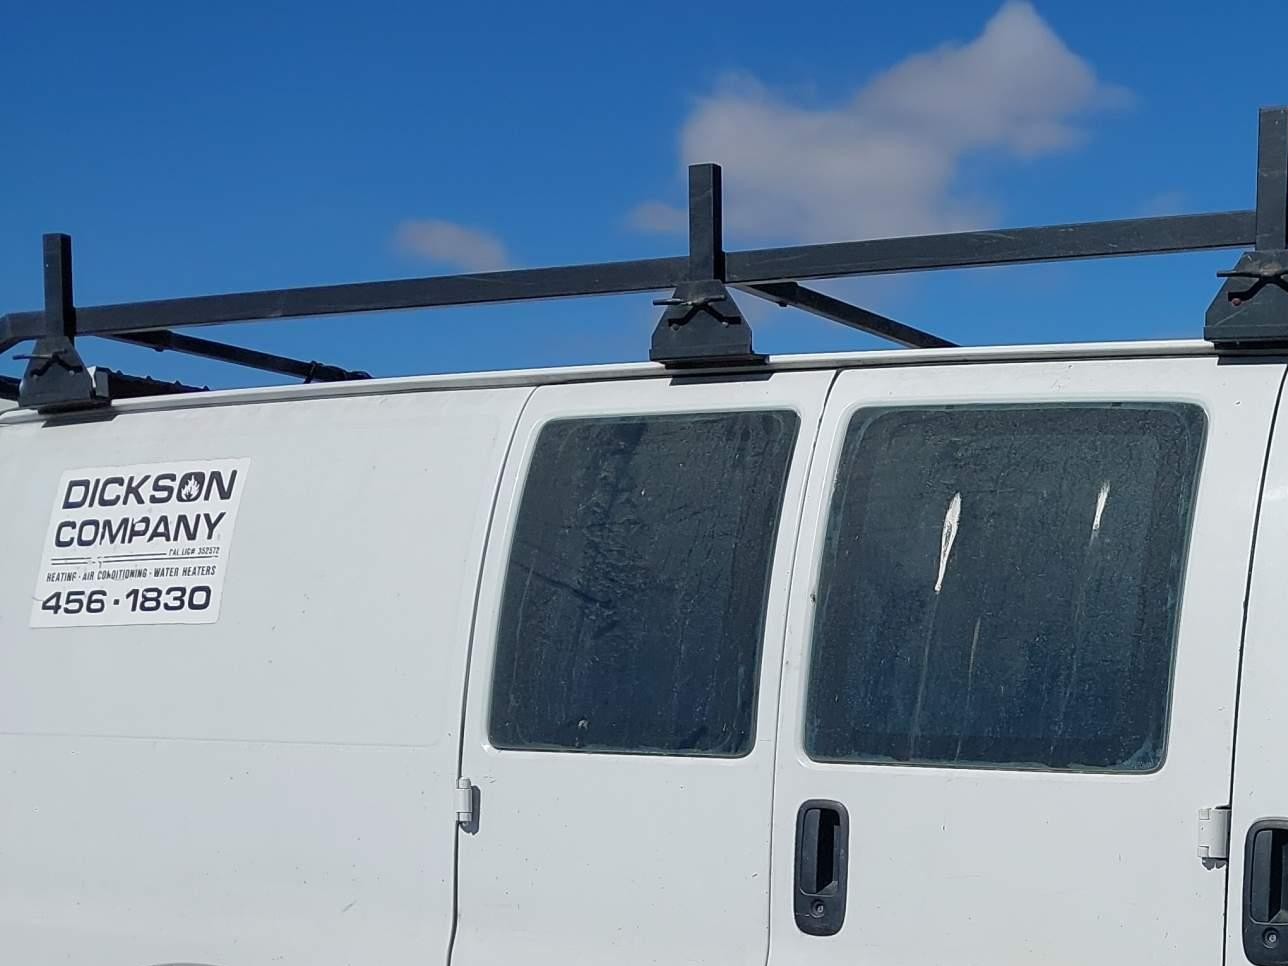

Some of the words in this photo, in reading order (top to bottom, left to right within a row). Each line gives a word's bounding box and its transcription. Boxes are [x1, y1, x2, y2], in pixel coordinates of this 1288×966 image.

[62, 469, 238, 510] DICKSON
[55, 512, 226, 548] COMPANY
[82, 570, 95, 581] AIR
[97, 568, 148, 581] CONDITIONING
[153, 567, 179, 577] WATER
[182, 565, 217, 577] HEATERS
